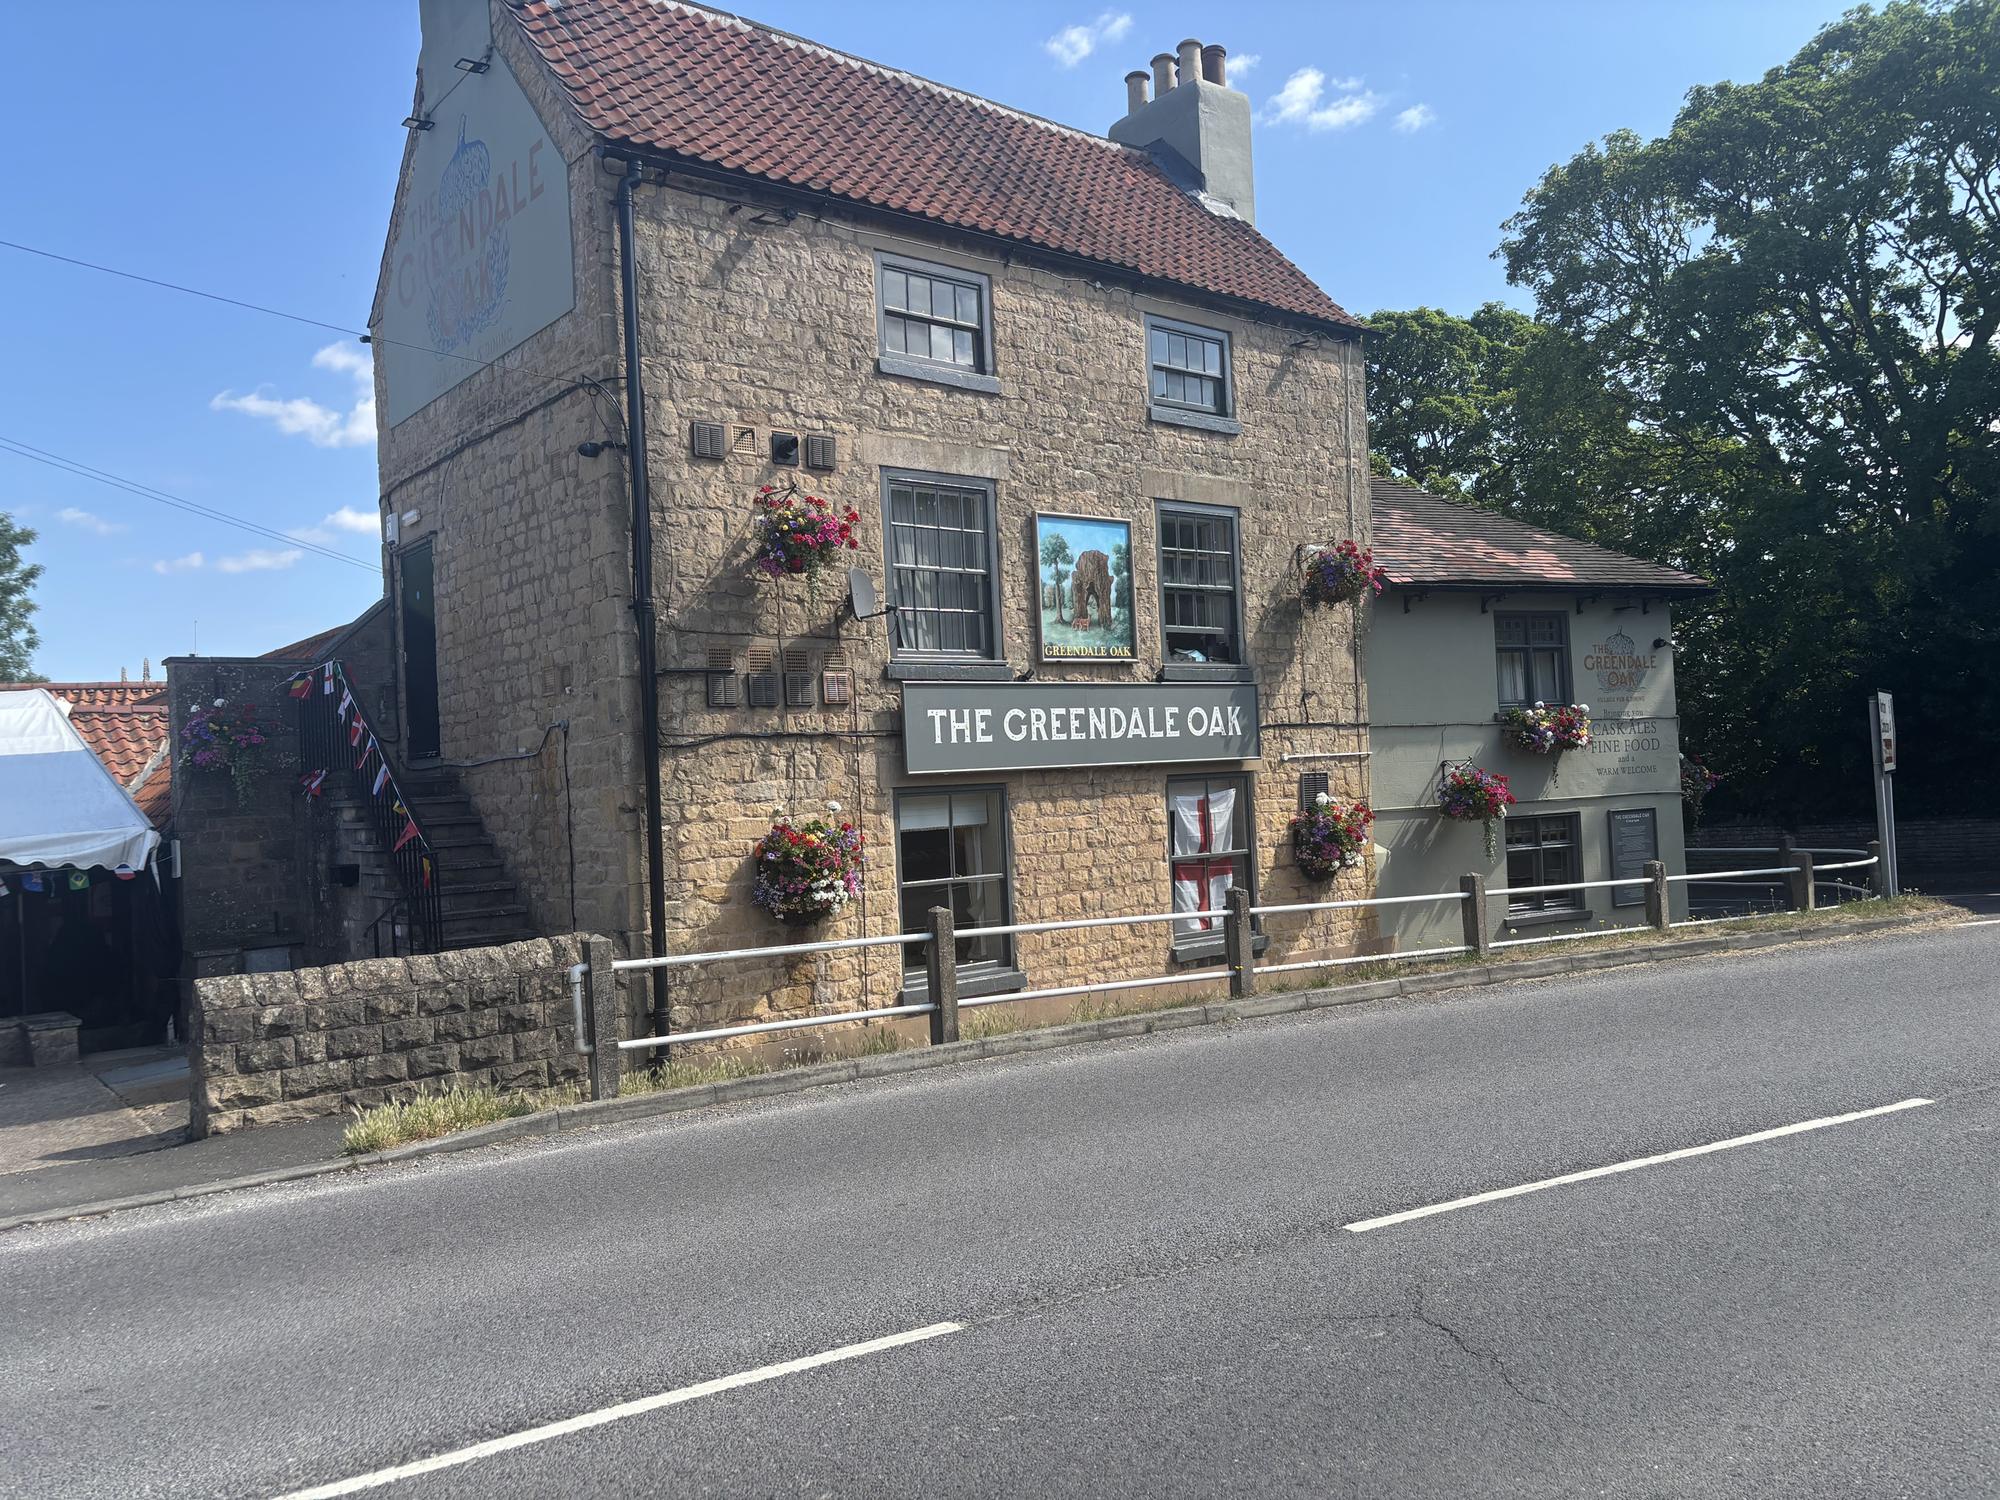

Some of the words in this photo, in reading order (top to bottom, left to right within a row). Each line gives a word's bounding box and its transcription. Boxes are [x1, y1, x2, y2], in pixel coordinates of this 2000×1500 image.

[1045, 645, 1107, 656] GREENDALE
[1110, 645, 1131, 656] OAK
[1592, 644, 1610, 655] THE
[1584, 655, 1657, 671] GREENDALE
[1607, 671, 1636, 688] OAK
[927, 708, 993, 744] THE
[1003, 706, 1180, 742] GREENDALE
[1187, 705, 1242, 737] OAK
[1592, 722, 1625, 736] CASK
[1629, 721, 1657, 734] ALES
[1591, 740, 1620, 753] FINE
[1624, 738, 1660, 752] FOOD
[1618, 754, 1630, 763] and
[1596, 767, 1619, 776] WARM
[1620, 765, 1658, 775] WELCOME
